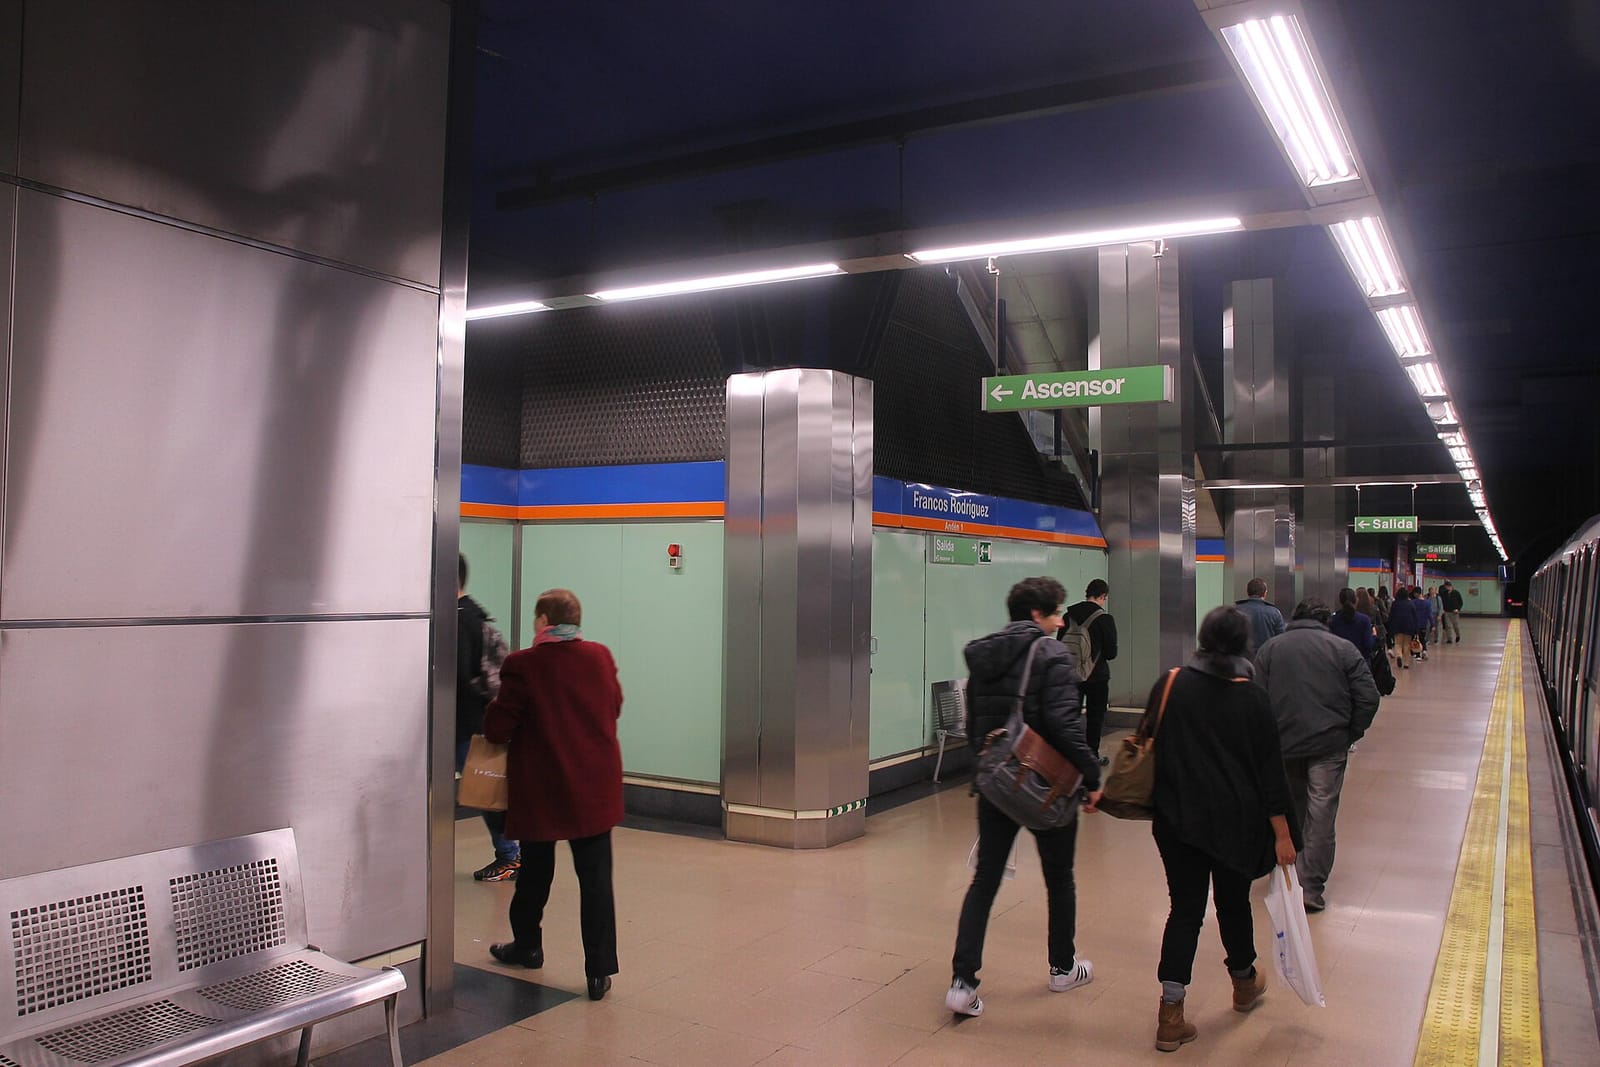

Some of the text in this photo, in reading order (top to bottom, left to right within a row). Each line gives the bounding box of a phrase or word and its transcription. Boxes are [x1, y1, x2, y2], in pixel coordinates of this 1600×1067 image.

[1021, 378, 1126, 400] Ascensor
[913, 490, 949, 512] Francos
[1372, 519, 1413, 529] Salida
[936, 540, 955, 552] Salida
[1428, 545, 1453, 553] Salida
